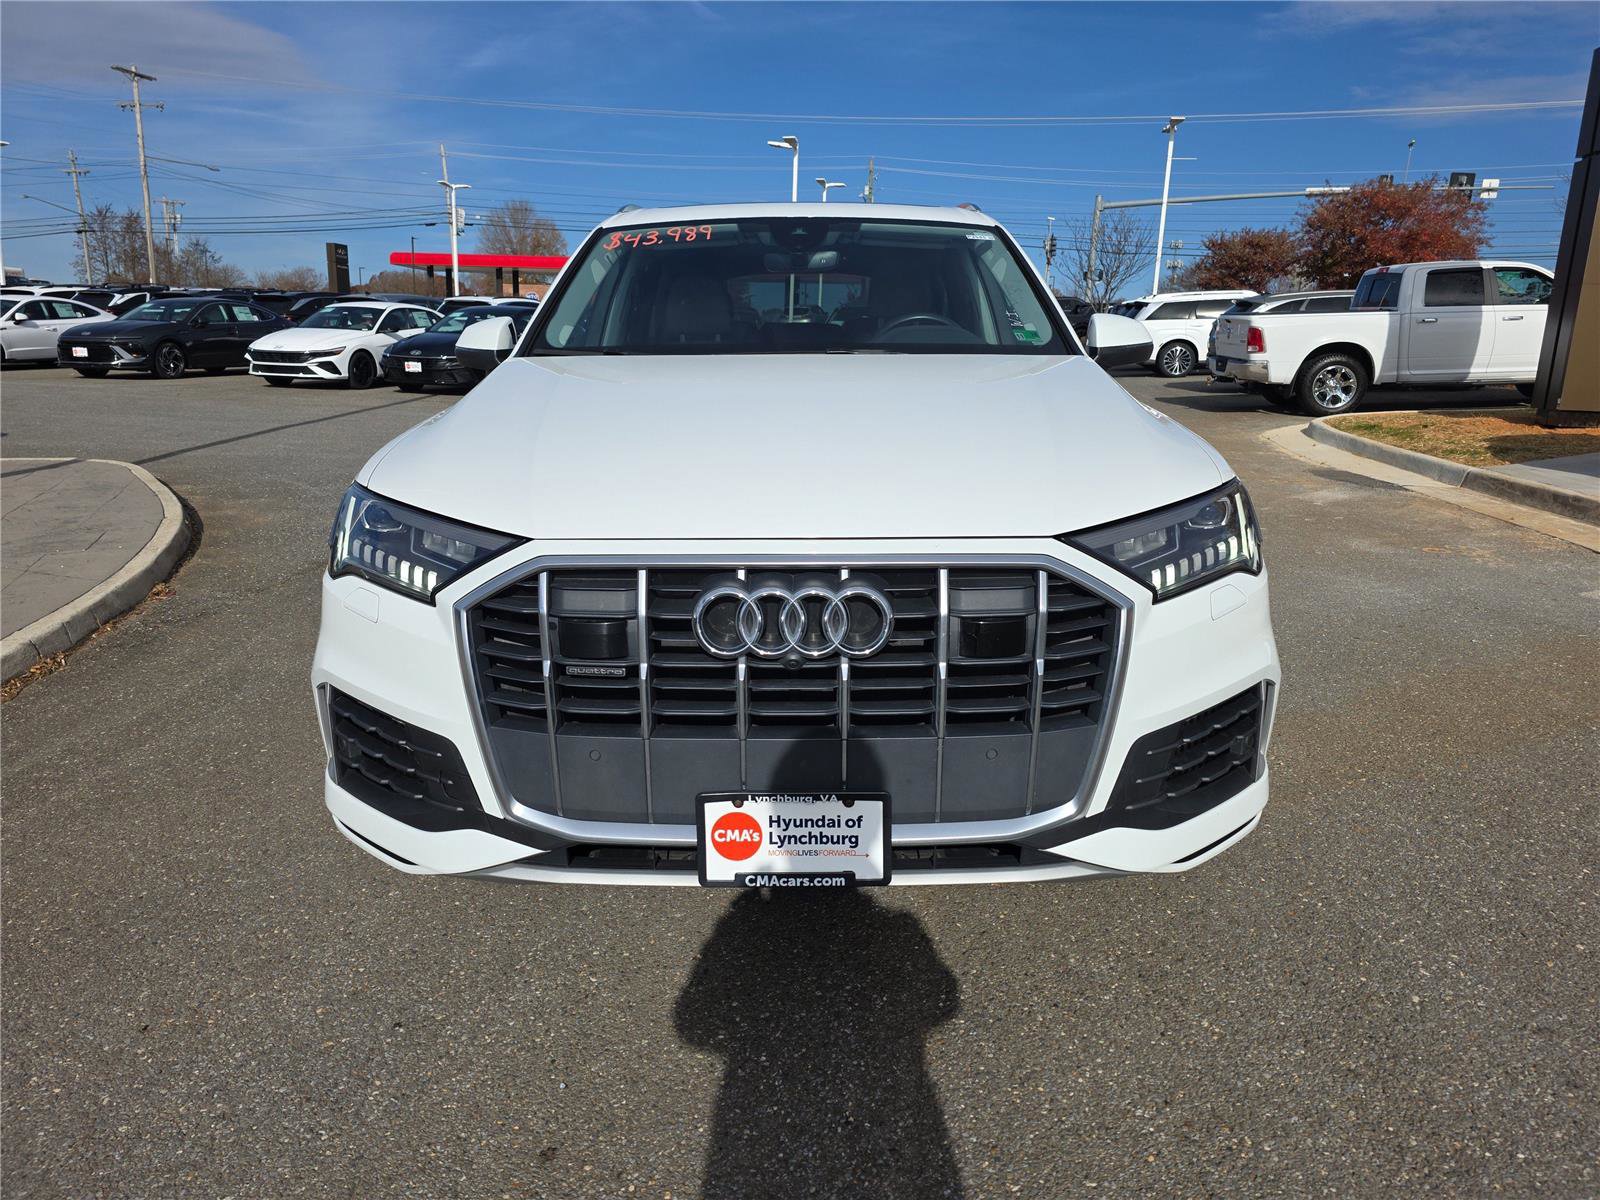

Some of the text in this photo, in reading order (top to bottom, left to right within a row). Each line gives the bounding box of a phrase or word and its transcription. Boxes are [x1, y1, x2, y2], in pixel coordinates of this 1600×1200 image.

[603, 225, 712, 250] $43,989
[568, 667, 624, 676] quattro
[768, 815, 863, 829] Hyundai of
[713, 829, 760, 843] CMA's
[768, 832, 859, 848] Lynchburg
[745, 875, 846, 887] CMAcars.com
